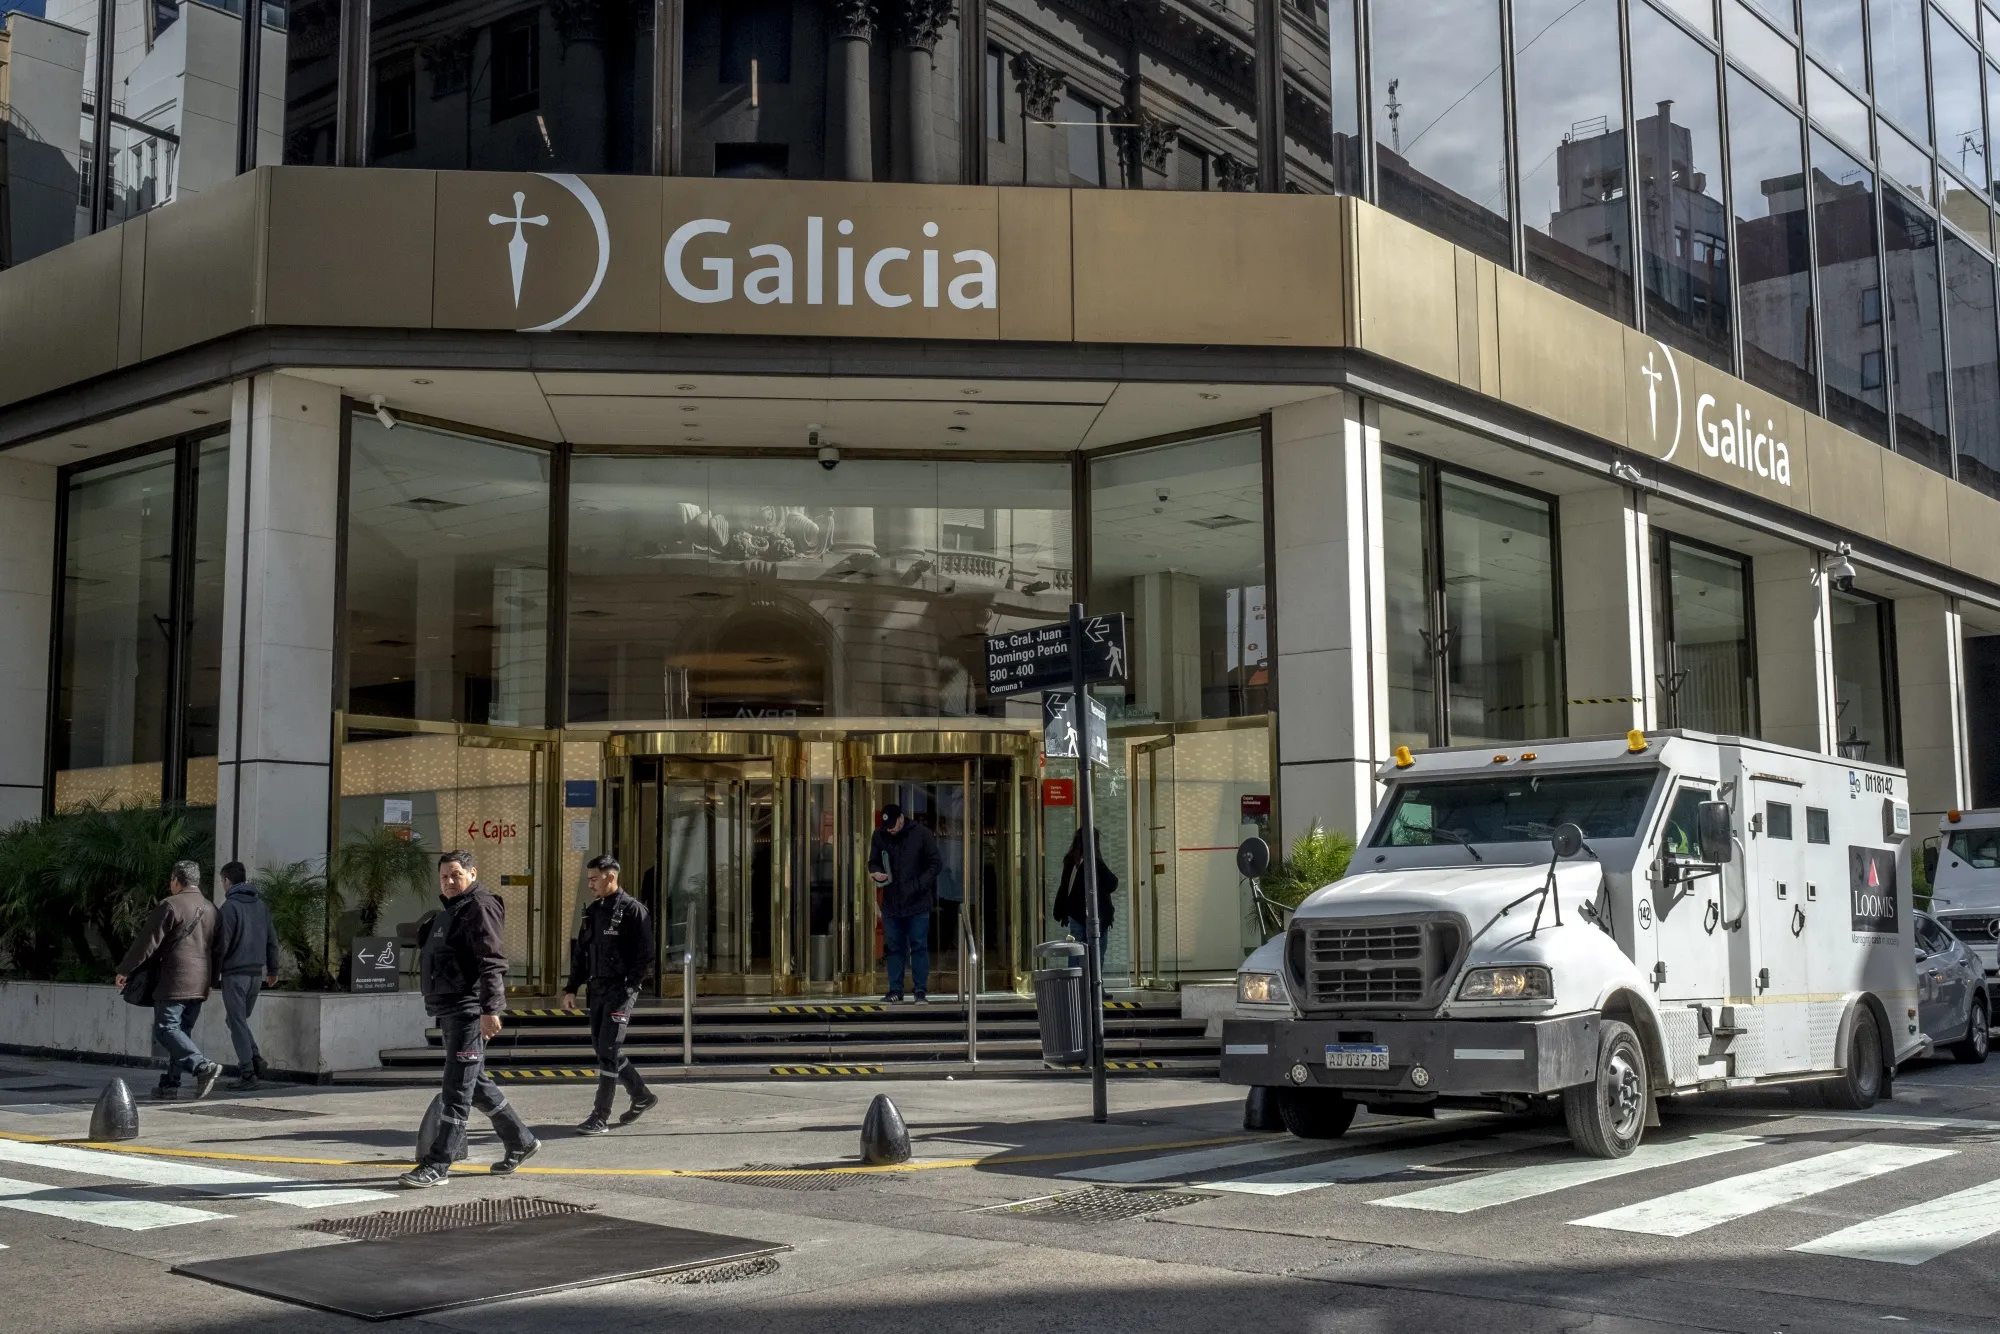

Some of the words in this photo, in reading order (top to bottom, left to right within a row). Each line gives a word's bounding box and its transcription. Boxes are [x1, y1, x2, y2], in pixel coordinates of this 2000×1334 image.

[664, 216, 998, 310] Galicia
[1696, 393, 1791, 486] Galicia
[988, 639, 1008, 651] Tte.
[1010, 632, 1034, 647] Gral.
[1037, 629, 1062, 642] Juan
[989, 649, 1035, 666] Domingo
[1037, 641, 1068, 657] Perón
[990, 668, 1008, 682] 500
[1015, 663, 1034, 676] 400
[990, 683, 1018, 693] Comuna
[1866, 773, 1894, 796] 0118142
[483, 820, 517, 844] Cajas
[1639, 906, 1651, 921] 142
[1854, 890, 1894, 918] LOOMIS
